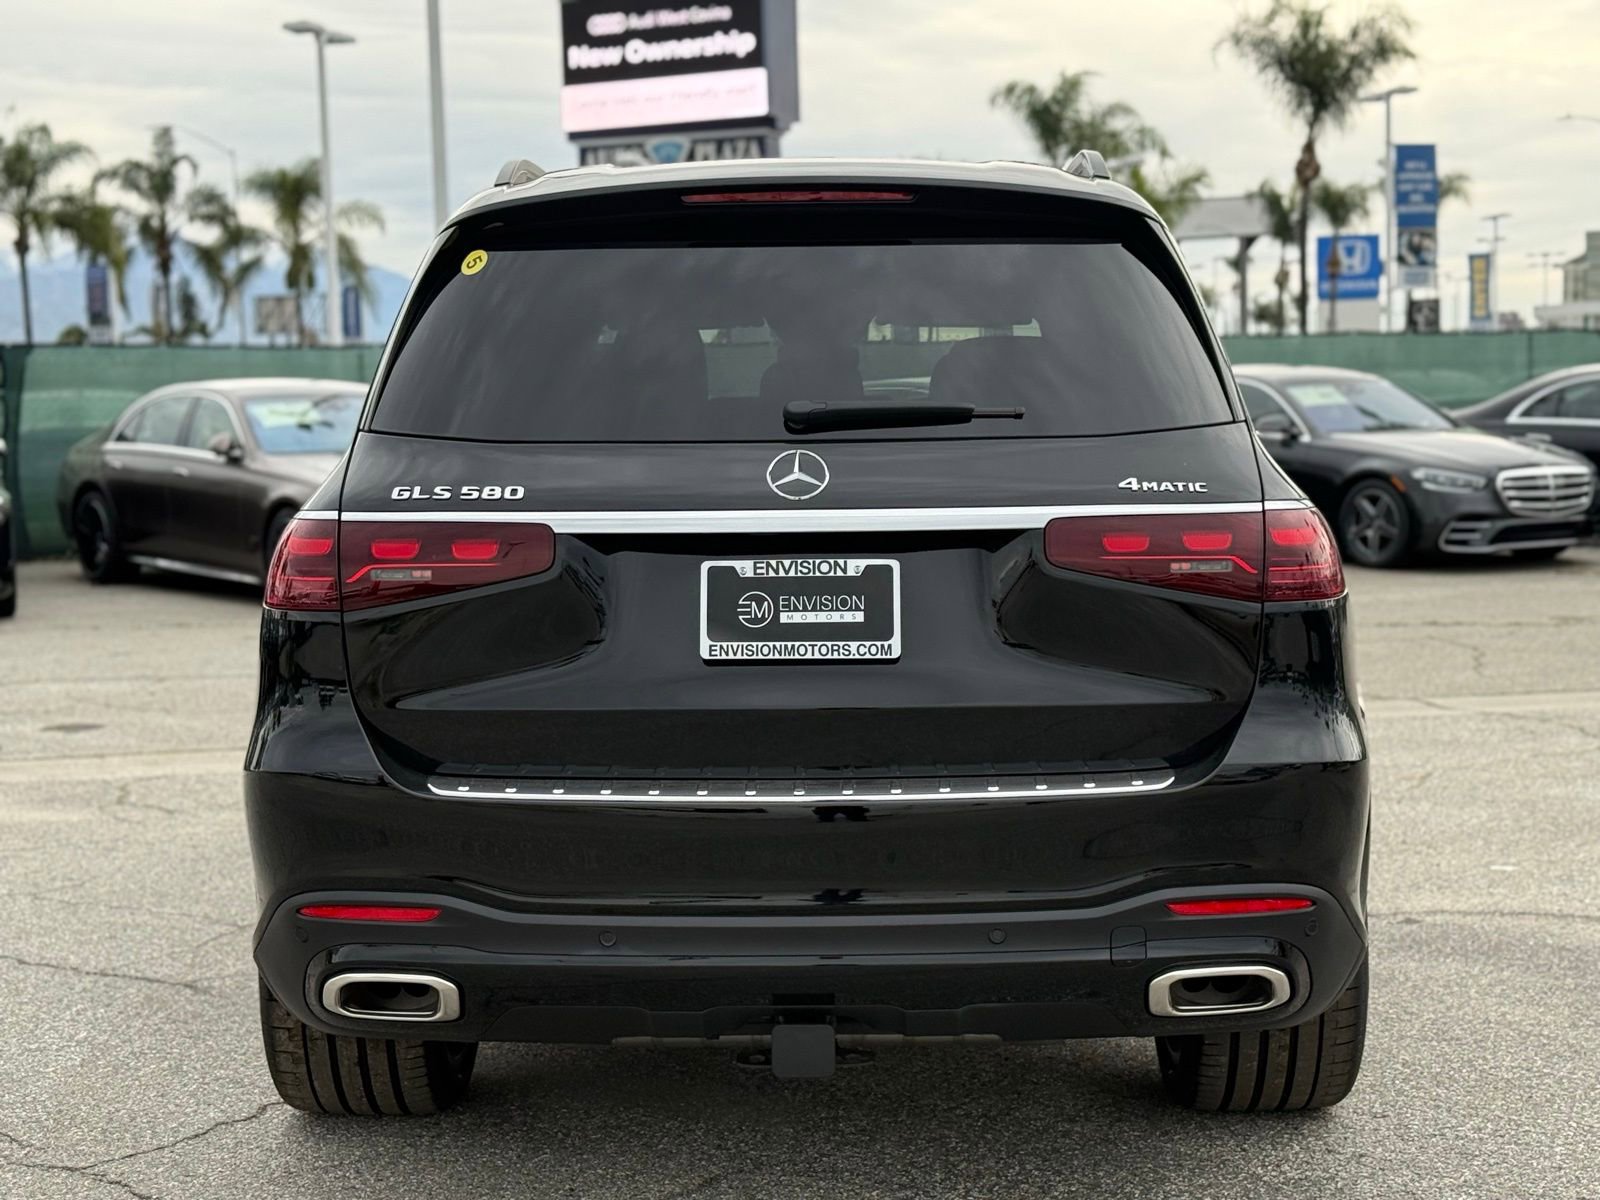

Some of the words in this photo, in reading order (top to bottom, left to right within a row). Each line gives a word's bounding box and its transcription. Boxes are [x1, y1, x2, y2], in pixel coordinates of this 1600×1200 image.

[567, 44, 624, 70] New
[624, 28, 758, 65] Ownership
[466, 254, 483, 270] 5
[391, 485, 453, 500] GLS
[459, 485, 525, 500] 580
[1118, 477, 1209, 493] 4MATIC
[753, 560, 848, 576] ENVISION
[779, 595, 865, 611] ENVISION
[786, 613, 858, 621] MOTORS
[708, 643, 892, 658] ENVISIONMOTORS.COM
